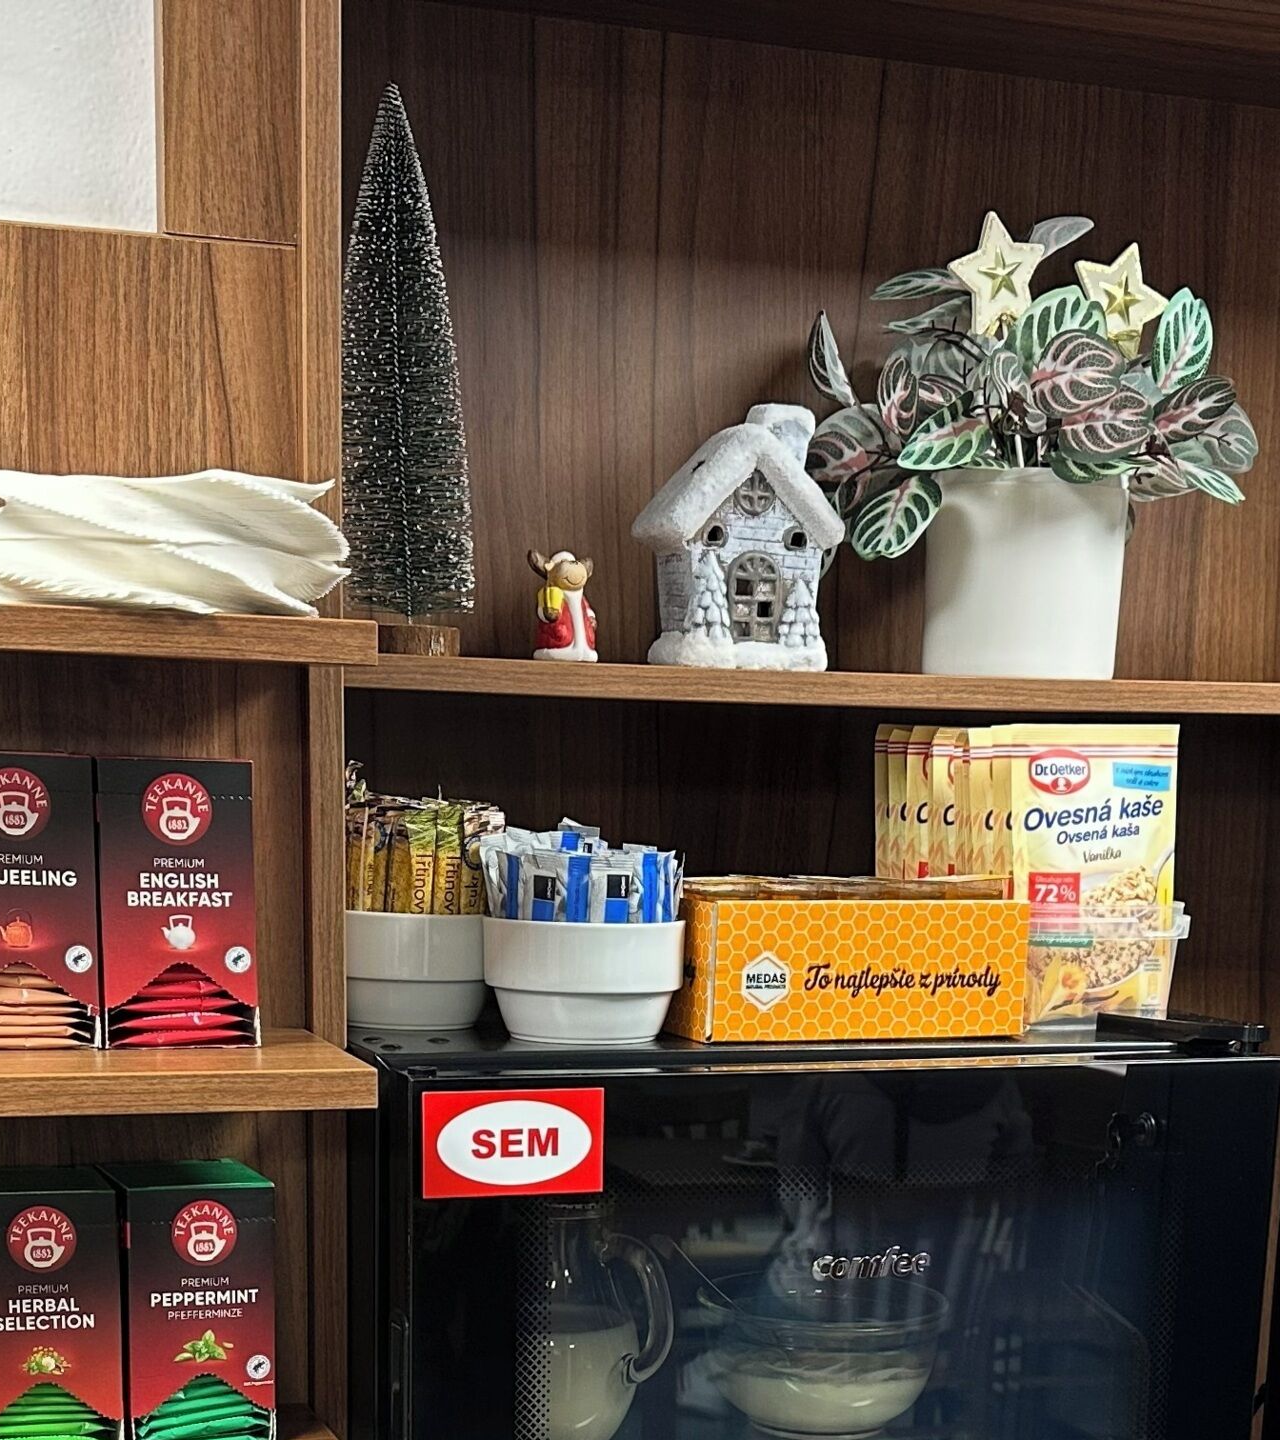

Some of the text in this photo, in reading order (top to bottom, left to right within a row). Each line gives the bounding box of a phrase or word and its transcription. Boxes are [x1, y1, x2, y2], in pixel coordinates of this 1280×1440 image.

[1049, 763, 1087, 776] Oetker
[145, 777, 210, 814] TEEKANNE
[1024, 794, 1164, 831] Ovesná kaše
[1056, 822, 1140, 845] Ovsená kaša
[153, 857, 205, 869] PREMIUM
[1083, 846, 1122, 864] Vanilka
[139, 872, 220, 890] ENGLISH
[126, 890, 233, 909] BREAKFAST
[746, 973, 786, 984] MEDAS
[804, 962, 1001, 998] To najlepšie z prírody
[471, 1127, 559, 1160] SEM
[9, 1210, 73, 1243] TEEKANNE
[174, 1204, 234, 1238] TEEKANNE
[17, 1283, 69, 1295] PREMIUM
[180, 1276, 230, 1288] PREMIUM
[8, 1297, 80, 1314] HERBAL
[150, 1288, 259, 1308] PEPPERMINT
[167, 1307, 243, 1320] PFEFFERMINZE
